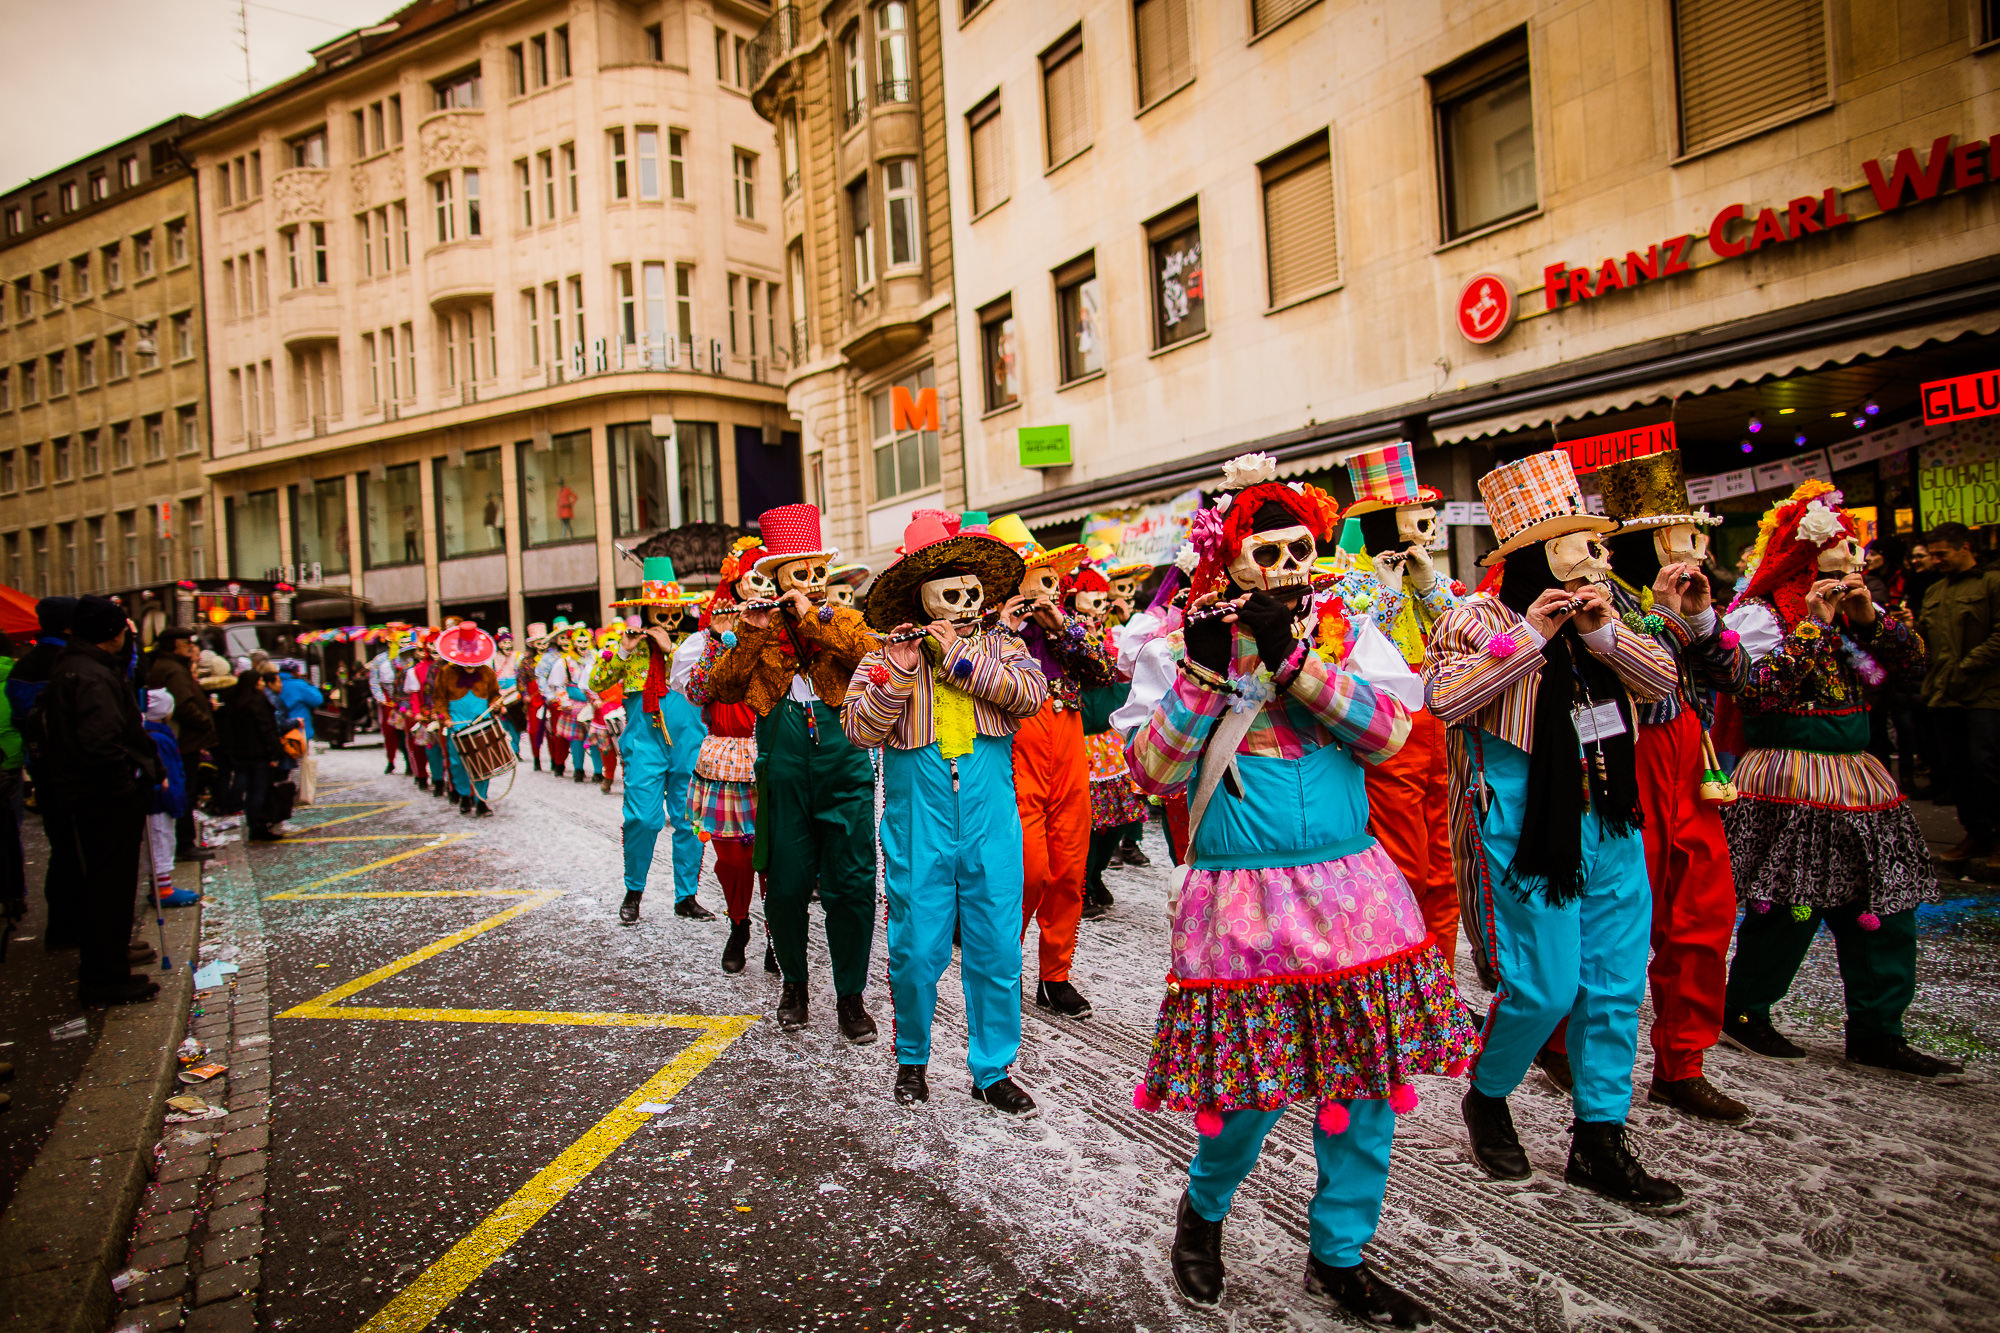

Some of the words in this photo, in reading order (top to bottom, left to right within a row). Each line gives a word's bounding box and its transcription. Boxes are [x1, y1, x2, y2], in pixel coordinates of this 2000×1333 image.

[1544, 233, 1691, 311] FRANZ
[1708, 187, 1850, 258] CARL
[572, 331, 725, 376] GRIEDER
[891, 386, 940, 431] M
[1557, 427, 1672, 470] LUHWEIN
[1933, 486, 1966, 510] HOT
